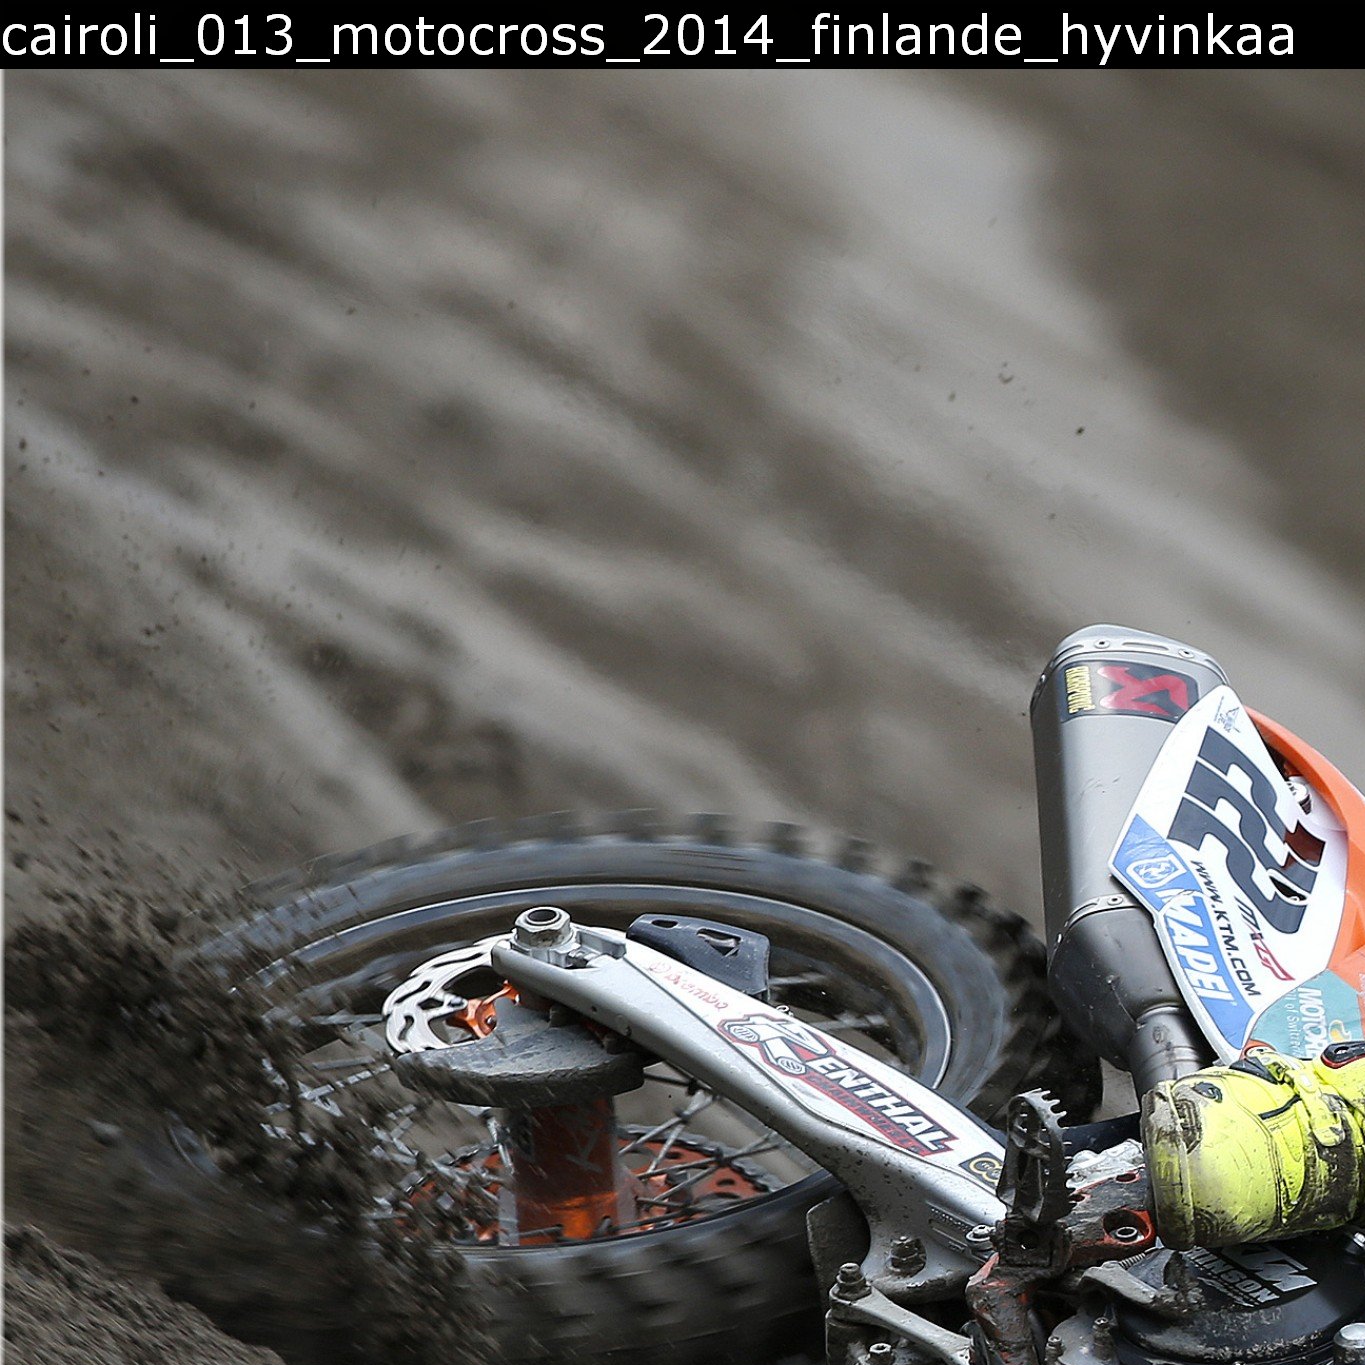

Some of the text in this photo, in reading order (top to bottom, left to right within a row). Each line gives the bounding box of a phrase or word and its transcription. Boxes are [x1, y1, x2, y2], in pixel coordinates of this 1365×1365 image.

[1167, 725, 1326, 934] 222
[1158, 886, 1237, 1007] MAPEI
[1192, 860, 1261, 998] WWW.KTM.COM
[1298, 988, 1327, 1058] MOTORE
